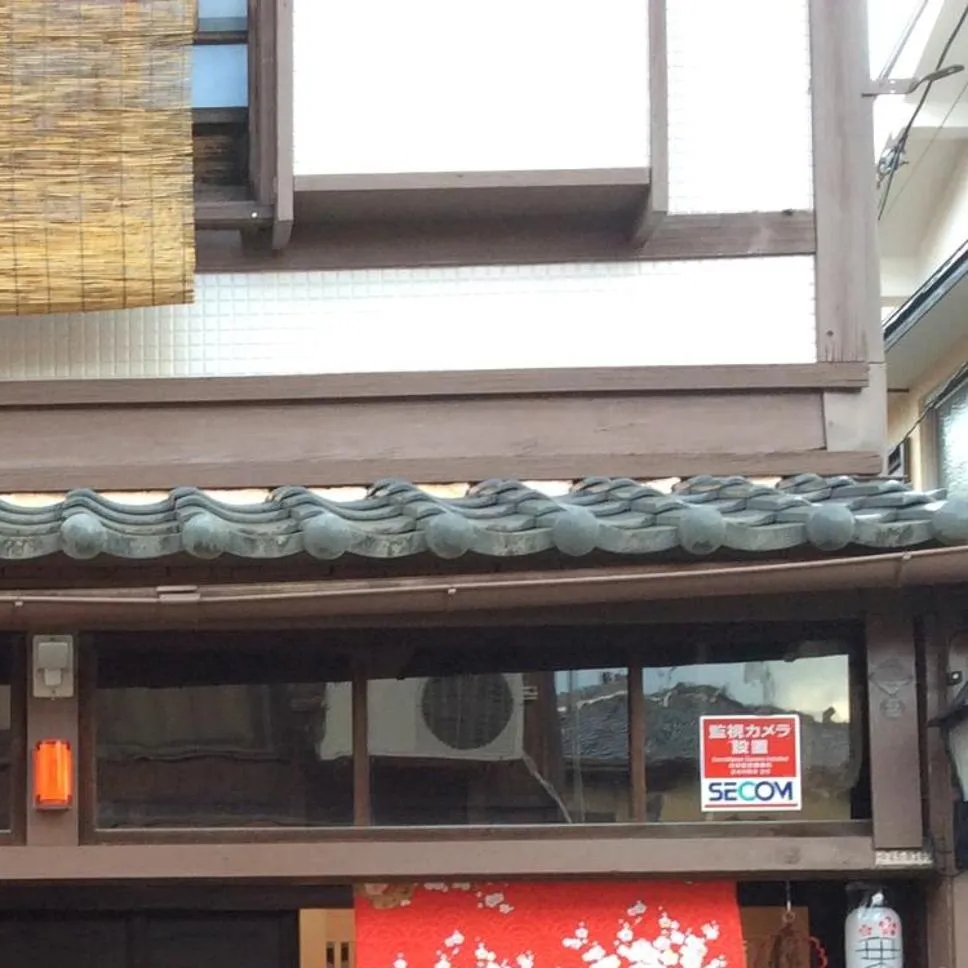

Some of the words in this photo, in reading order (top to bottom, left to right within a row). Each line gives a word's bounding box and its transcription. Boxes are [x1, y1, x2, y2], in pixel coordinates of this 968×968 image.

[708, 724, 791, 739] 監視カメラ
[708, 781, 793, 801] SECOM
